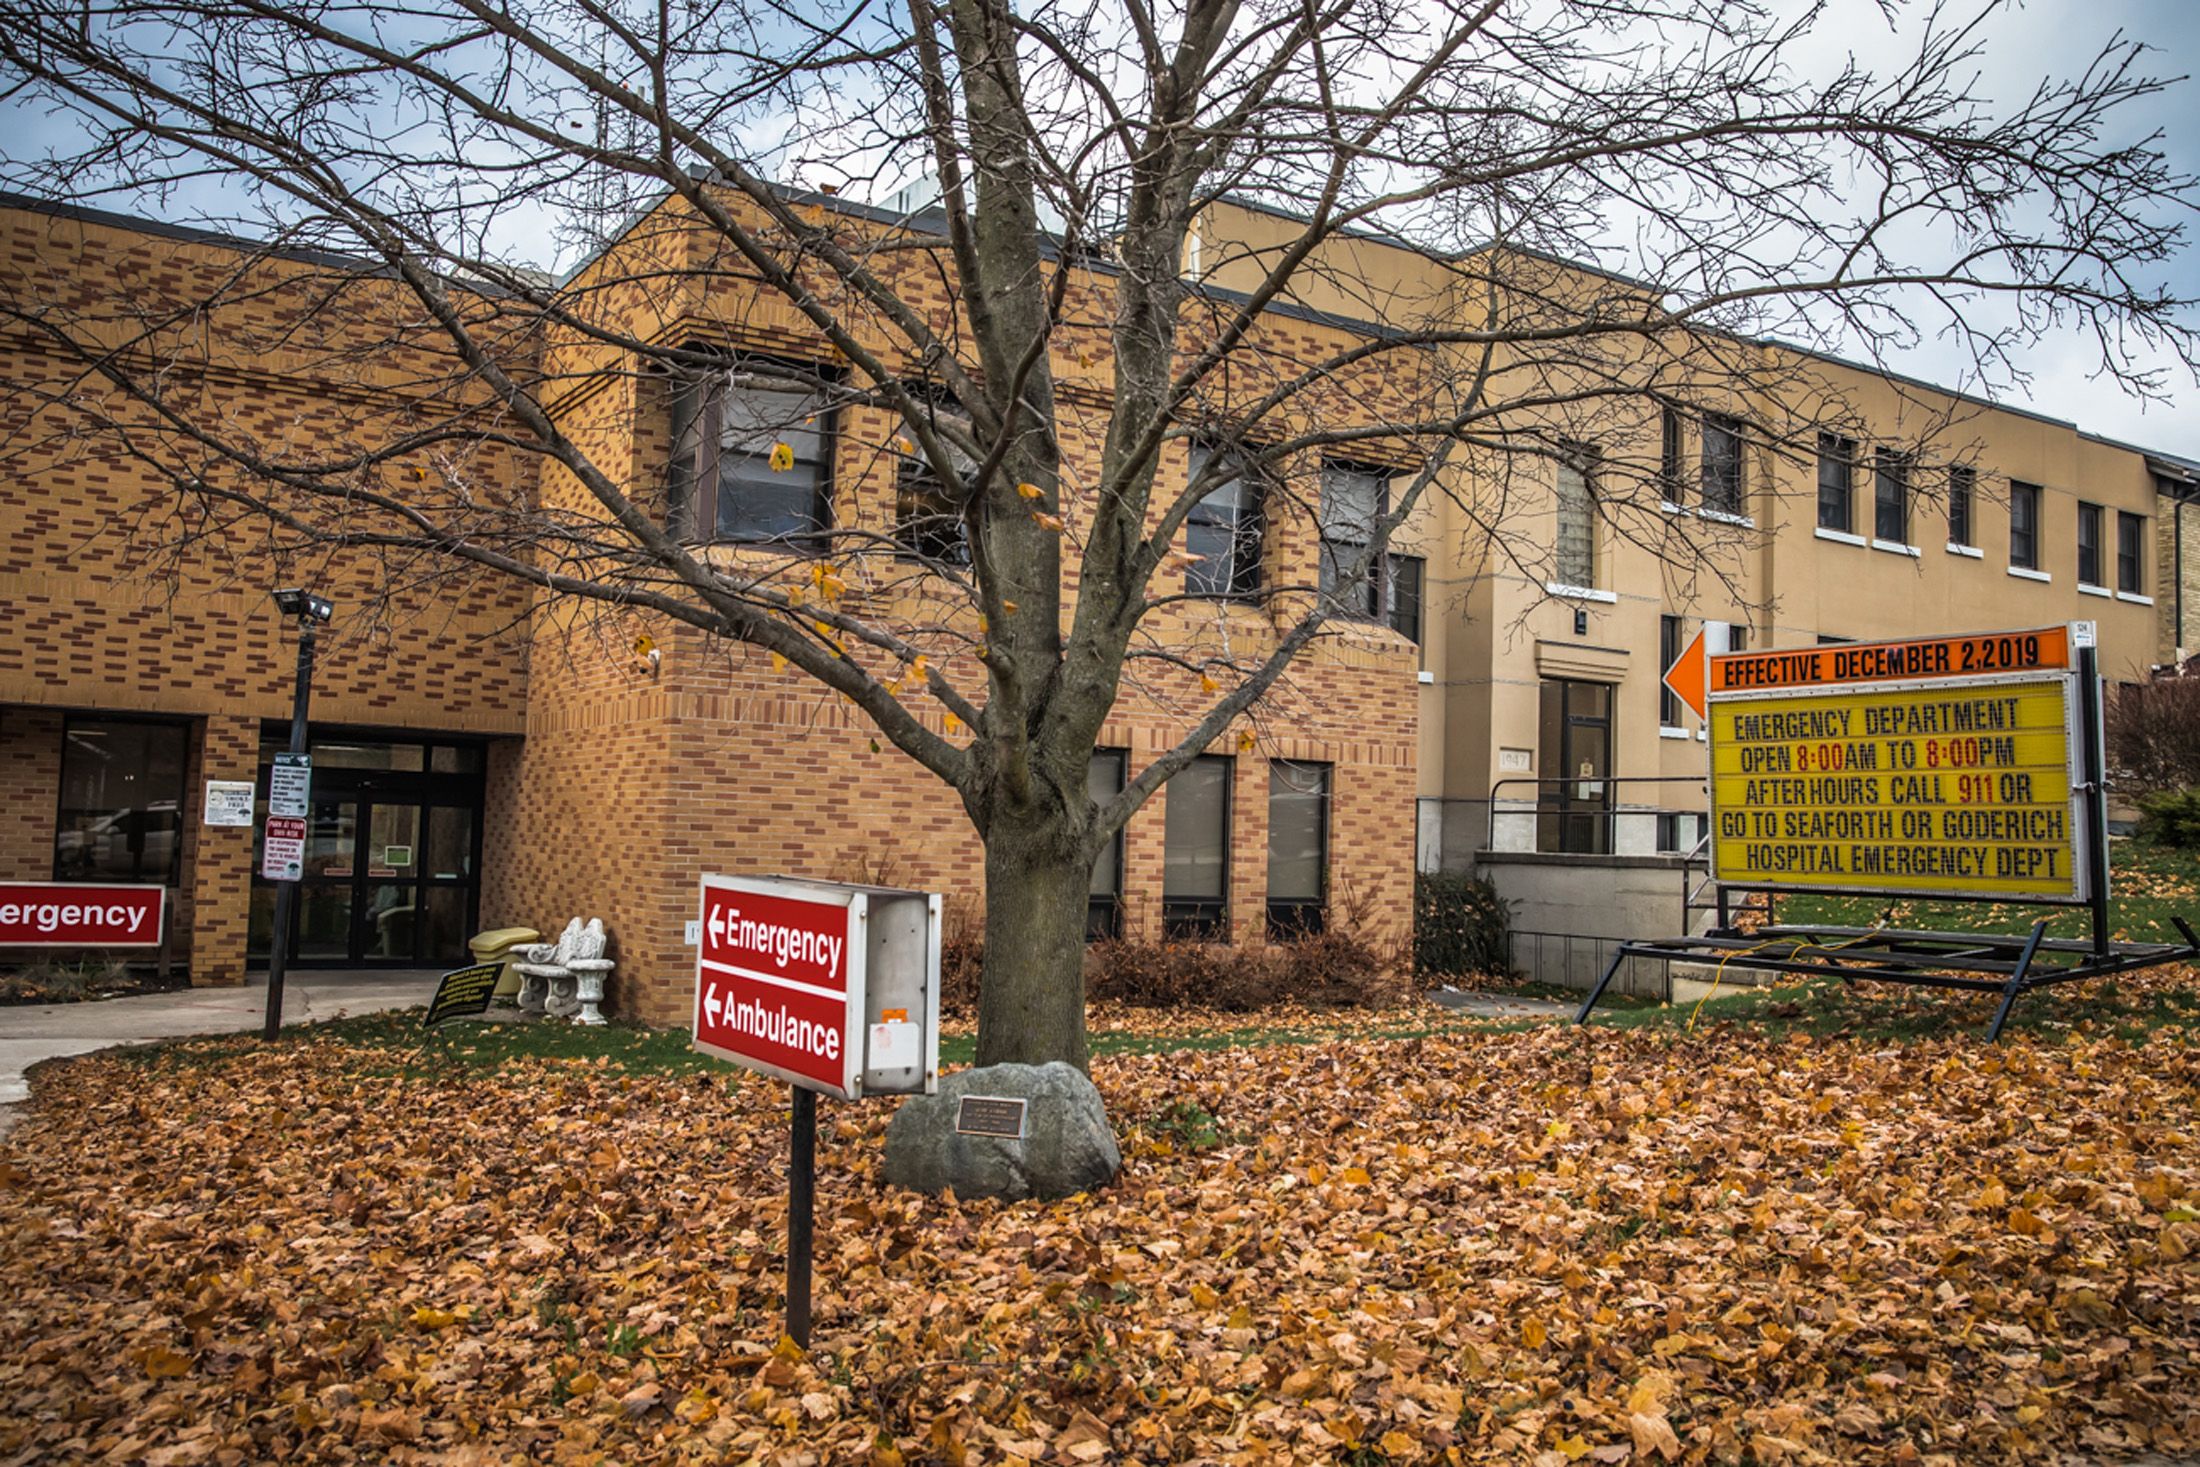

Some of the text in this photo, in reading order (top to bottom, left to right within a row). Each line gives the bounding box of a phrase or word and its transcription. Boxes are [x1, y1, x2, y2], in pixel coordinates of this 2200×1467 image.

[1724, 654, 1821, 687] EFFECTIVE
[1834, 643, 1950, 679] DECEMBER
[1734, 698, 2019, 741] EMERGENCY DEPARTMENT
[1741, 736, 2015, 772] OPEN 8:00AM TO 8:00PM
[1891, 776, 1946, 804] CALL
[1959, 774, 1993, 803] 911
[2000, 772, 2032, 803] OR
[1722, 810, 2063, 840] GO TO SEAFORTH OR GODERICH
[1747, 844, 2058, 878] HOSPITAL EMERGENCY DEPT
[0, 904, 147, 933] ergency
[726, 908, 842, 978] Emergency
[722, 990, 839, 1060] Ambulance
